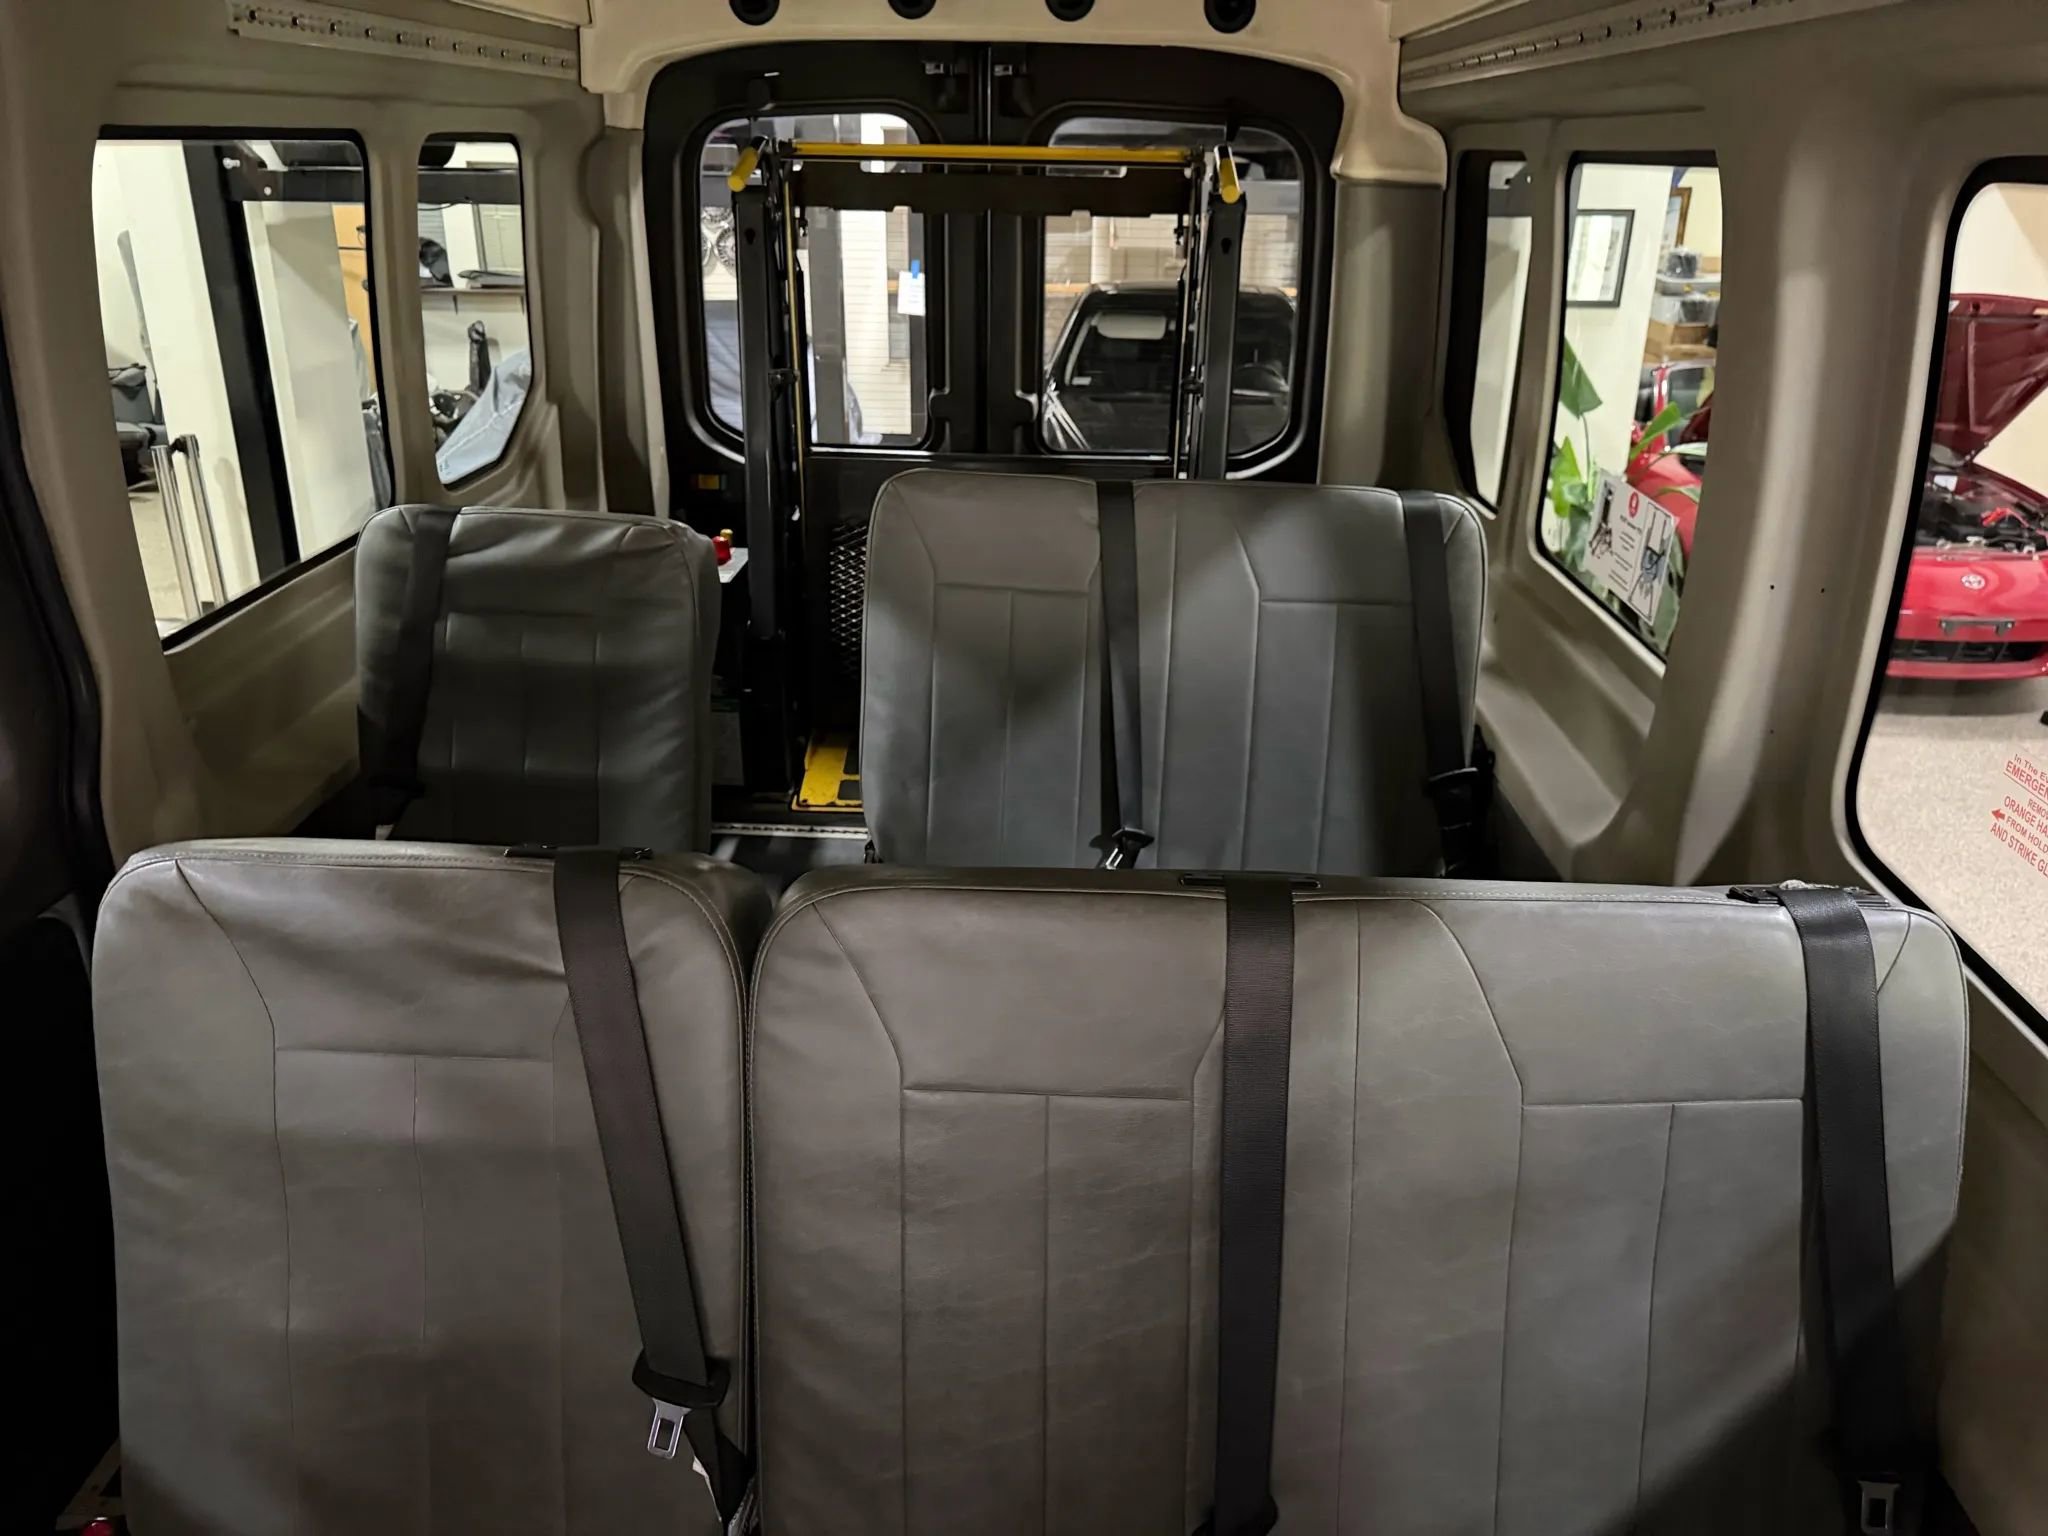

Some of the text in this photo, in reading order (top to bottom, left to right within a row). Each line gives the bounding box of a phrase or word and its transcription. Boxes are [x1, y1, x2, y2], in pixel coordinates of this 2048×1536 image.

[2014, 753, 2022, 765] In
[2024, 759, 2038, 776] The
[2004, 795, 2036, 828] ORANGE
[2006, 815, 2027, 838] FROM
[1990, 822, 2008, 842] AND
[2008, 835, 2038, 867] STRIKE
